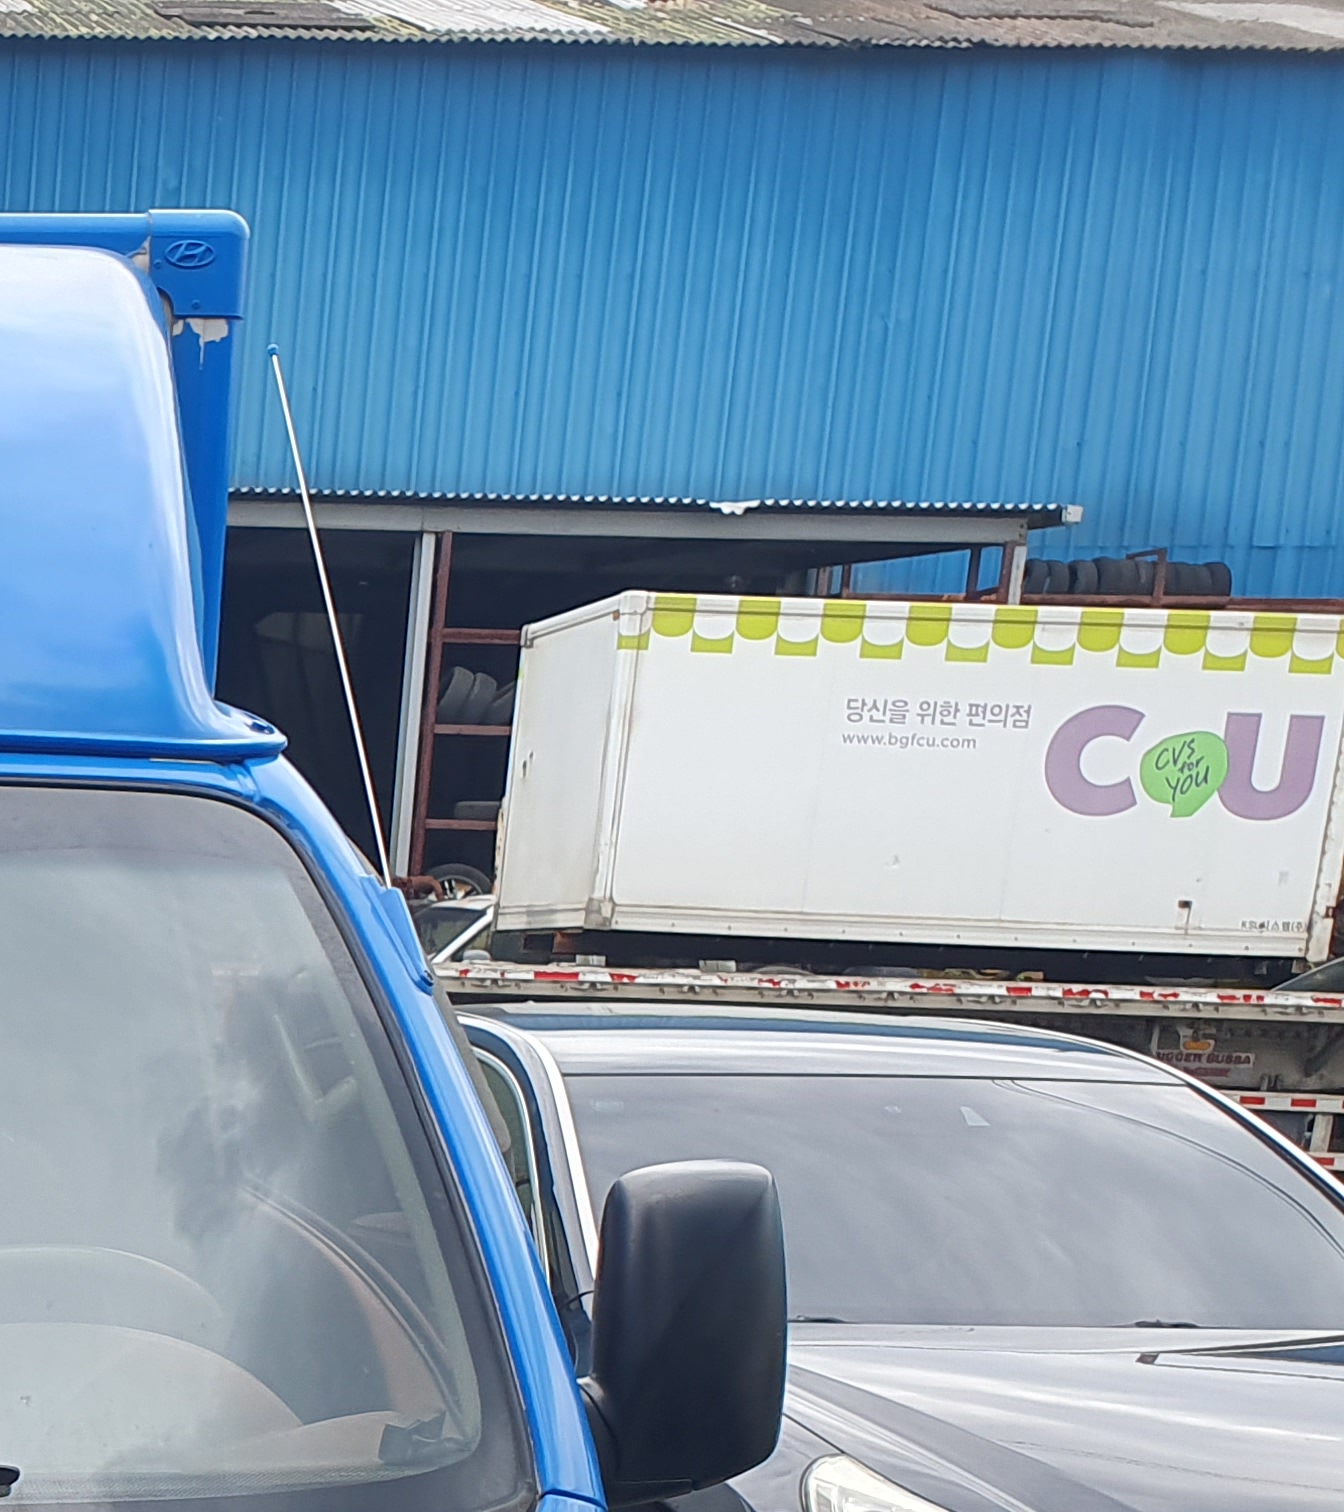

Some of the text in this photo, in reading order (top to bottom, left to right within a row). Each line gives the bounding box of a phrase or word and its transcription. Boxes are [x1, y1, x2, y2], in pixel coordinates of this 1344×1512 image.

[846, 697, 1033, 729] 당신을 위한 편의점
[841, 731, 977, 750] www.bgfcu.com
[1154, 737, 1197, 772] CVS
[1044, 704, 1326, 822] CU
[1177, 755, 1205, 775] for
[1164, 765, 1211, 804] YOU
